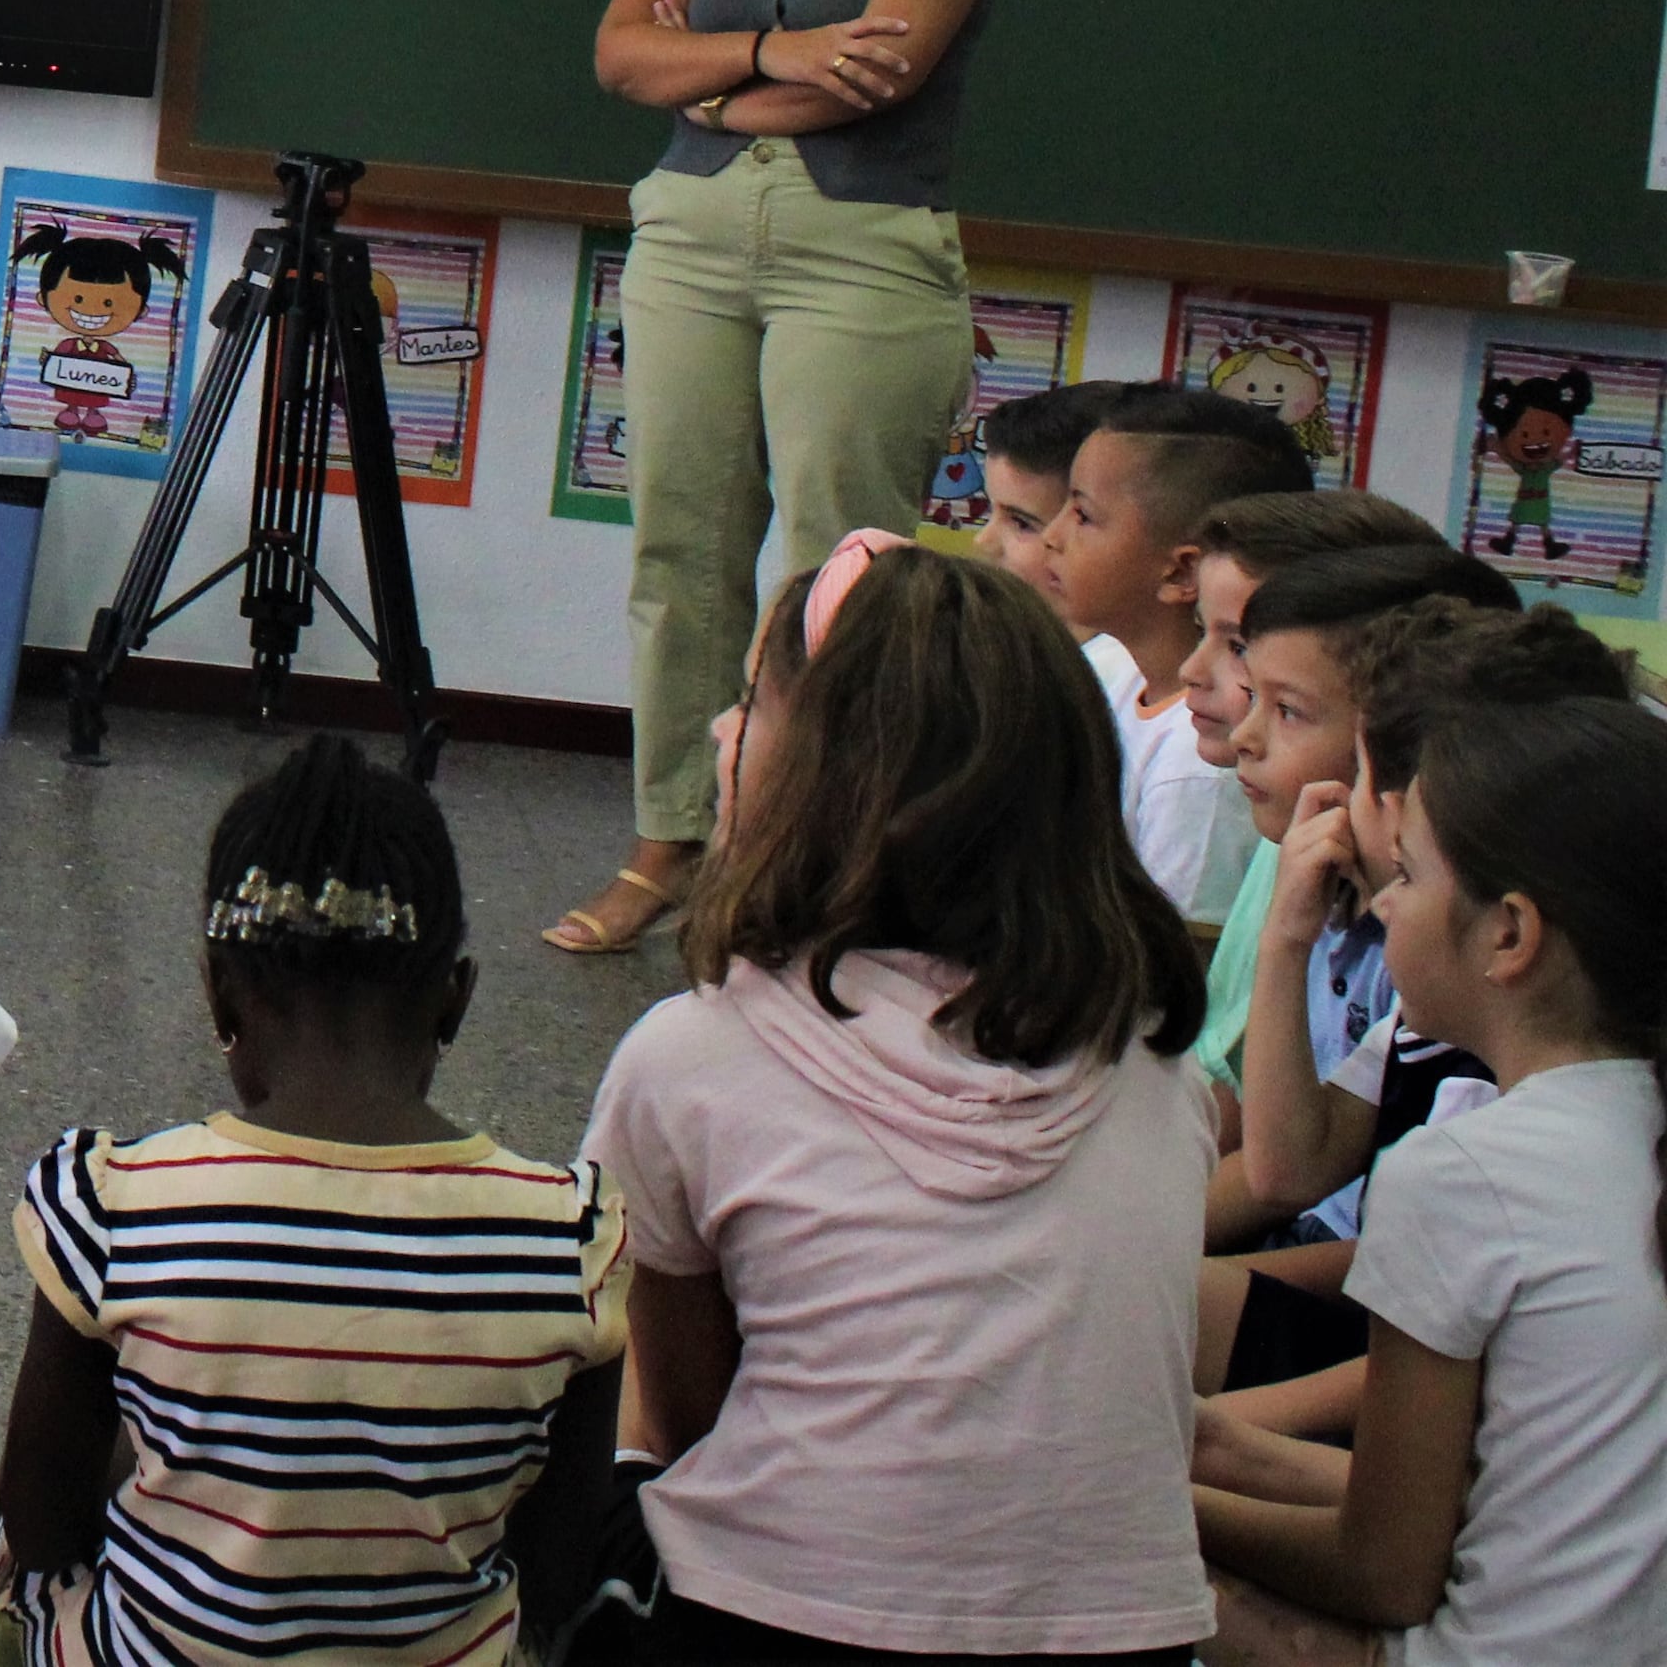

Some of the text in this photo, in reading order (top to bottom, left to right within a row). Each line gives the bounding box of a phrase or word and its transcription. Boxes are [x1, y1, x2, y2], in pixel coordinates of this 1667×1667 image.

[401, 331, 479, 360] Martes
[56, 358, 123, 389] Lunes
[1578, 447, 1663, 473] Sábado
